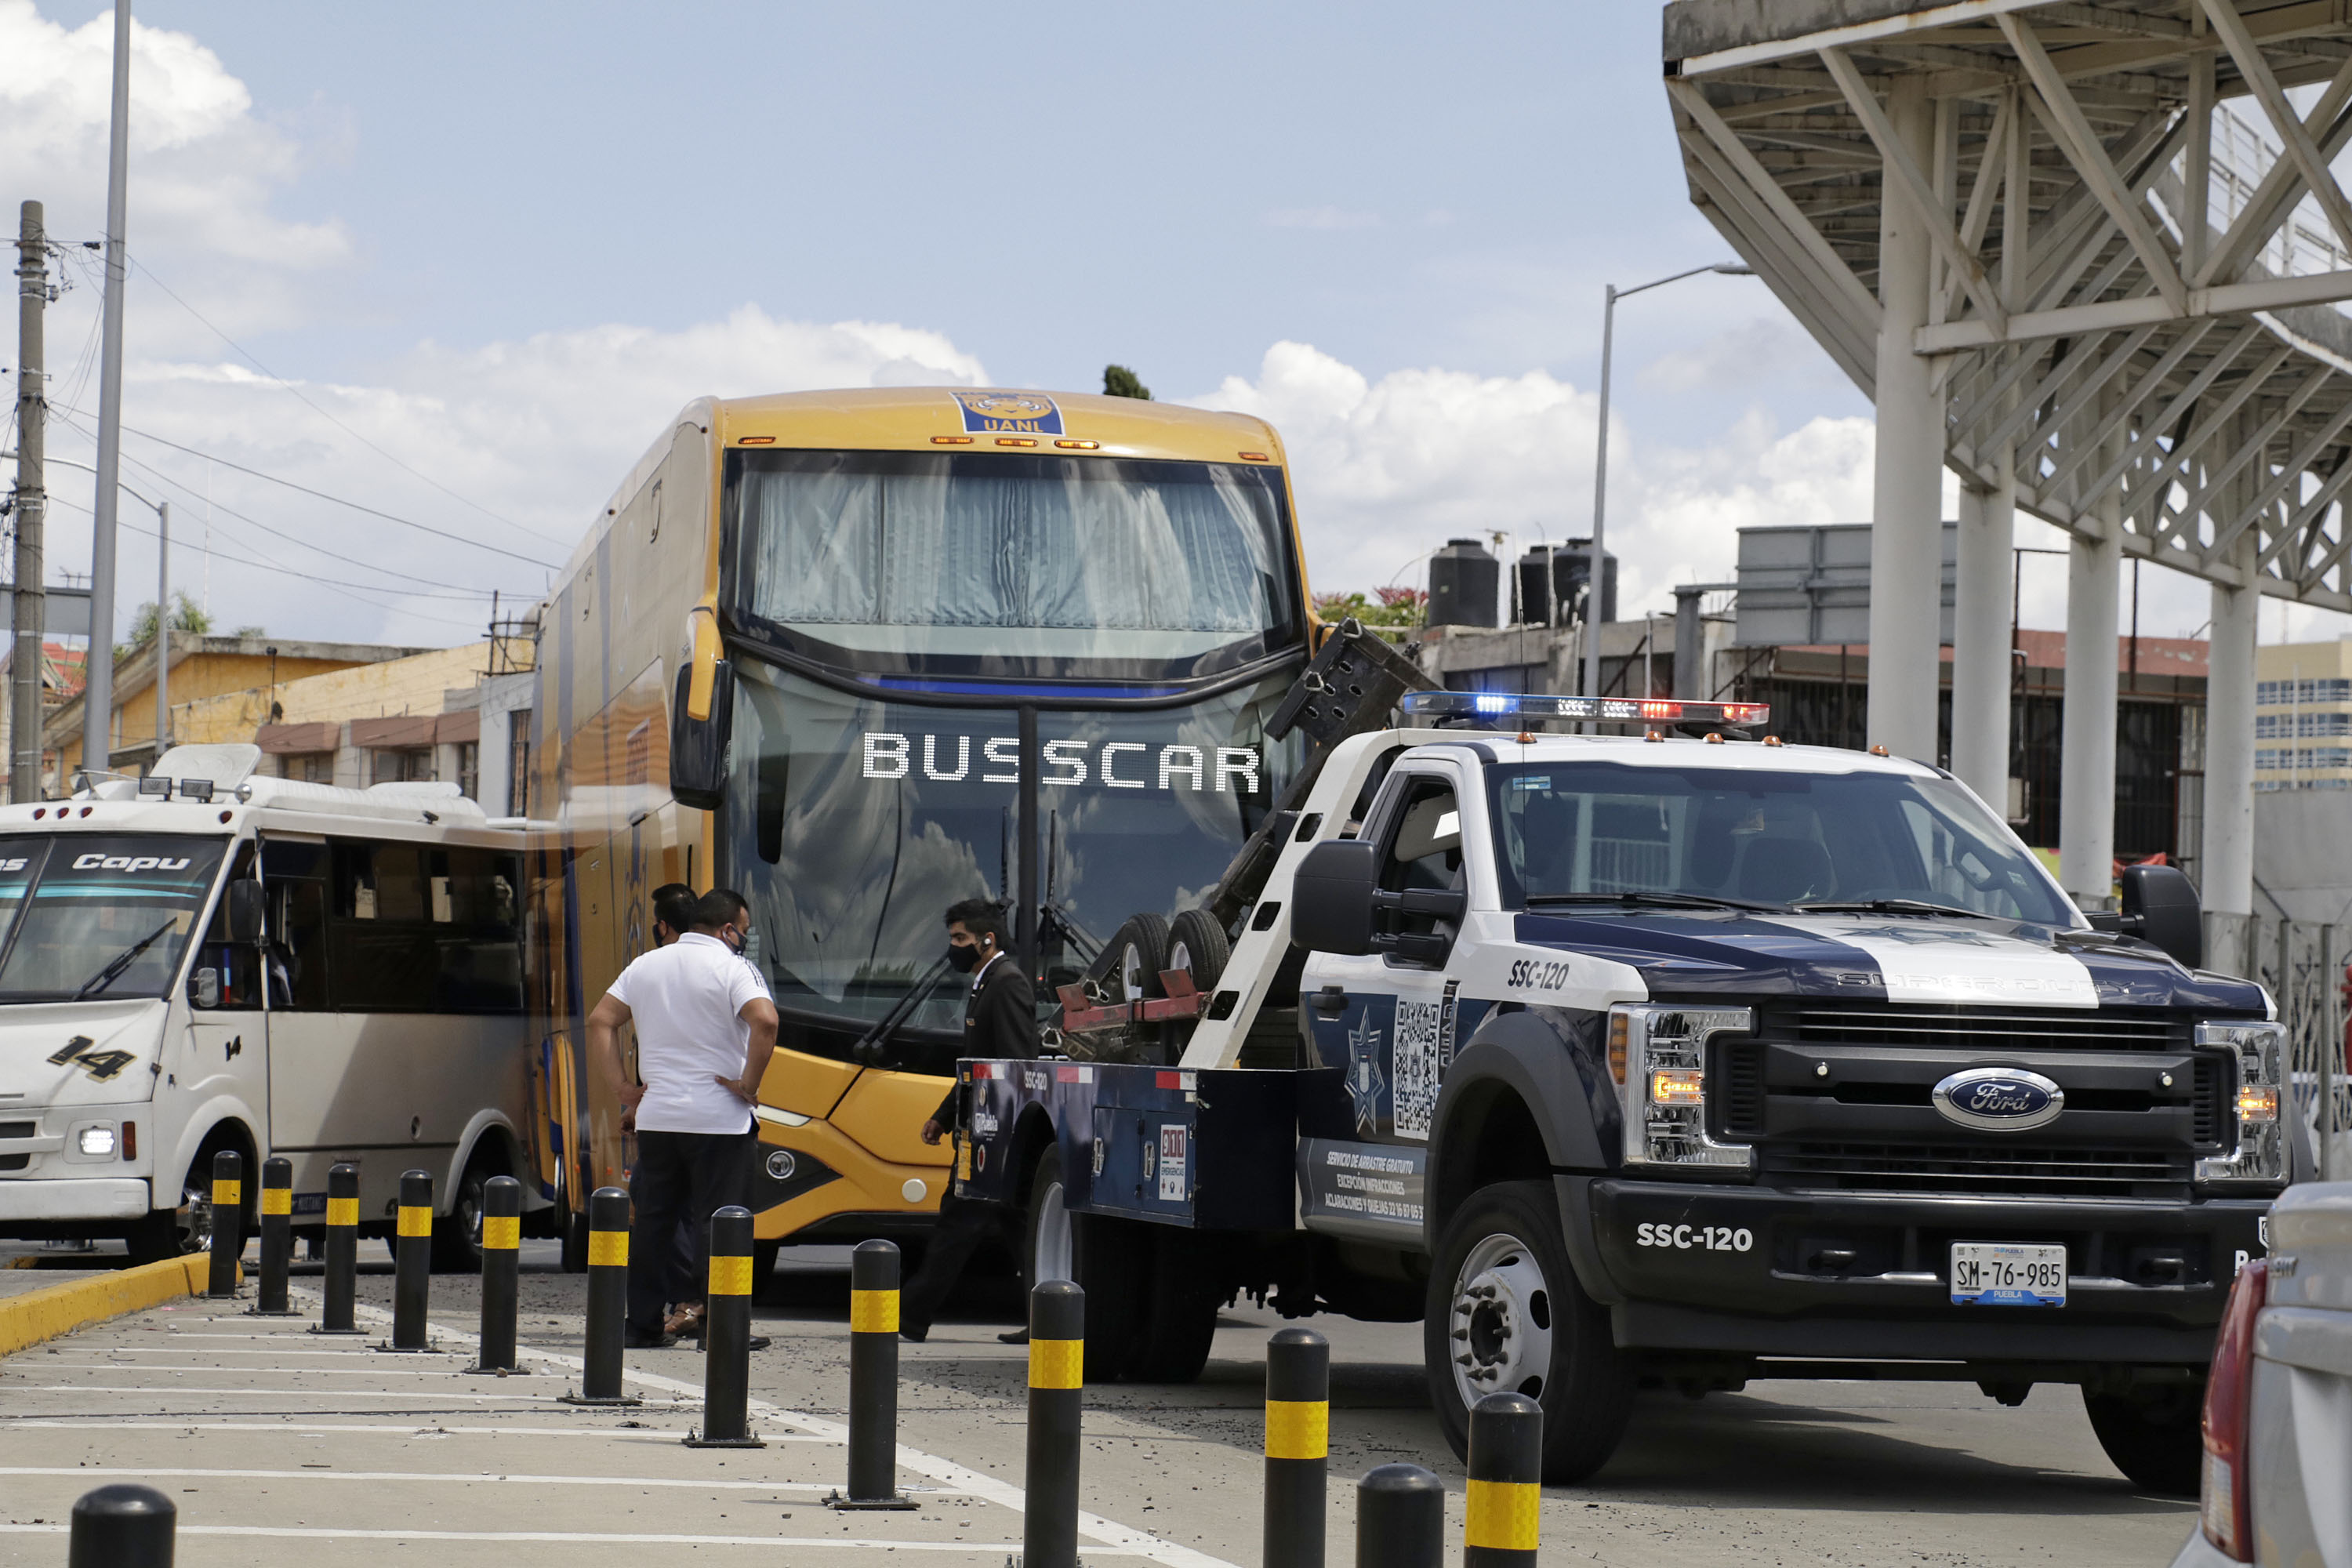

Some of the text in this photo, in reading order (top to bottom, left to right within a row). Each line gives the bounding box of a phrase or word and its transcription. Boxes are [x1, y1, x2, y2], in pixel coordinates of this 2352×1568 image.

[984, 419, 1044, 433] UANL
[862, 731, 1260, 793] BUSSCAR
[72, 853, 191, 873] Capu
[1508, 959, 1570, 991] SSC-120
[1836, 972, 2135, 995] SUPER DUTY
[45, 1034, 138, 1084] 14
[226, 1034, 241, 1062] 14
[1025, 1071, 1047, 1091] SSC-120
[1970, 1083, 2031, 1111] Ford
[1163, 1132, 1184, 1155] 911
[1327, 1151, 1414, 1174] SERVICIO DE ARRASTRE GRATUITO
[1325, 1192, 1363, 1211] ACLARACIONES
[1363, 1198, 1367, 1212] Y
[1367, 1199, 1388, 1215] QUEJAS
[1388, 1201, 1396, 1216] 22
[1636, 1222, 1753, 1252] SSC-120
[1957, 1261, 2061, 1287] SM-76-985
[1994, 1290, 2022, 1298] PUEBLA
